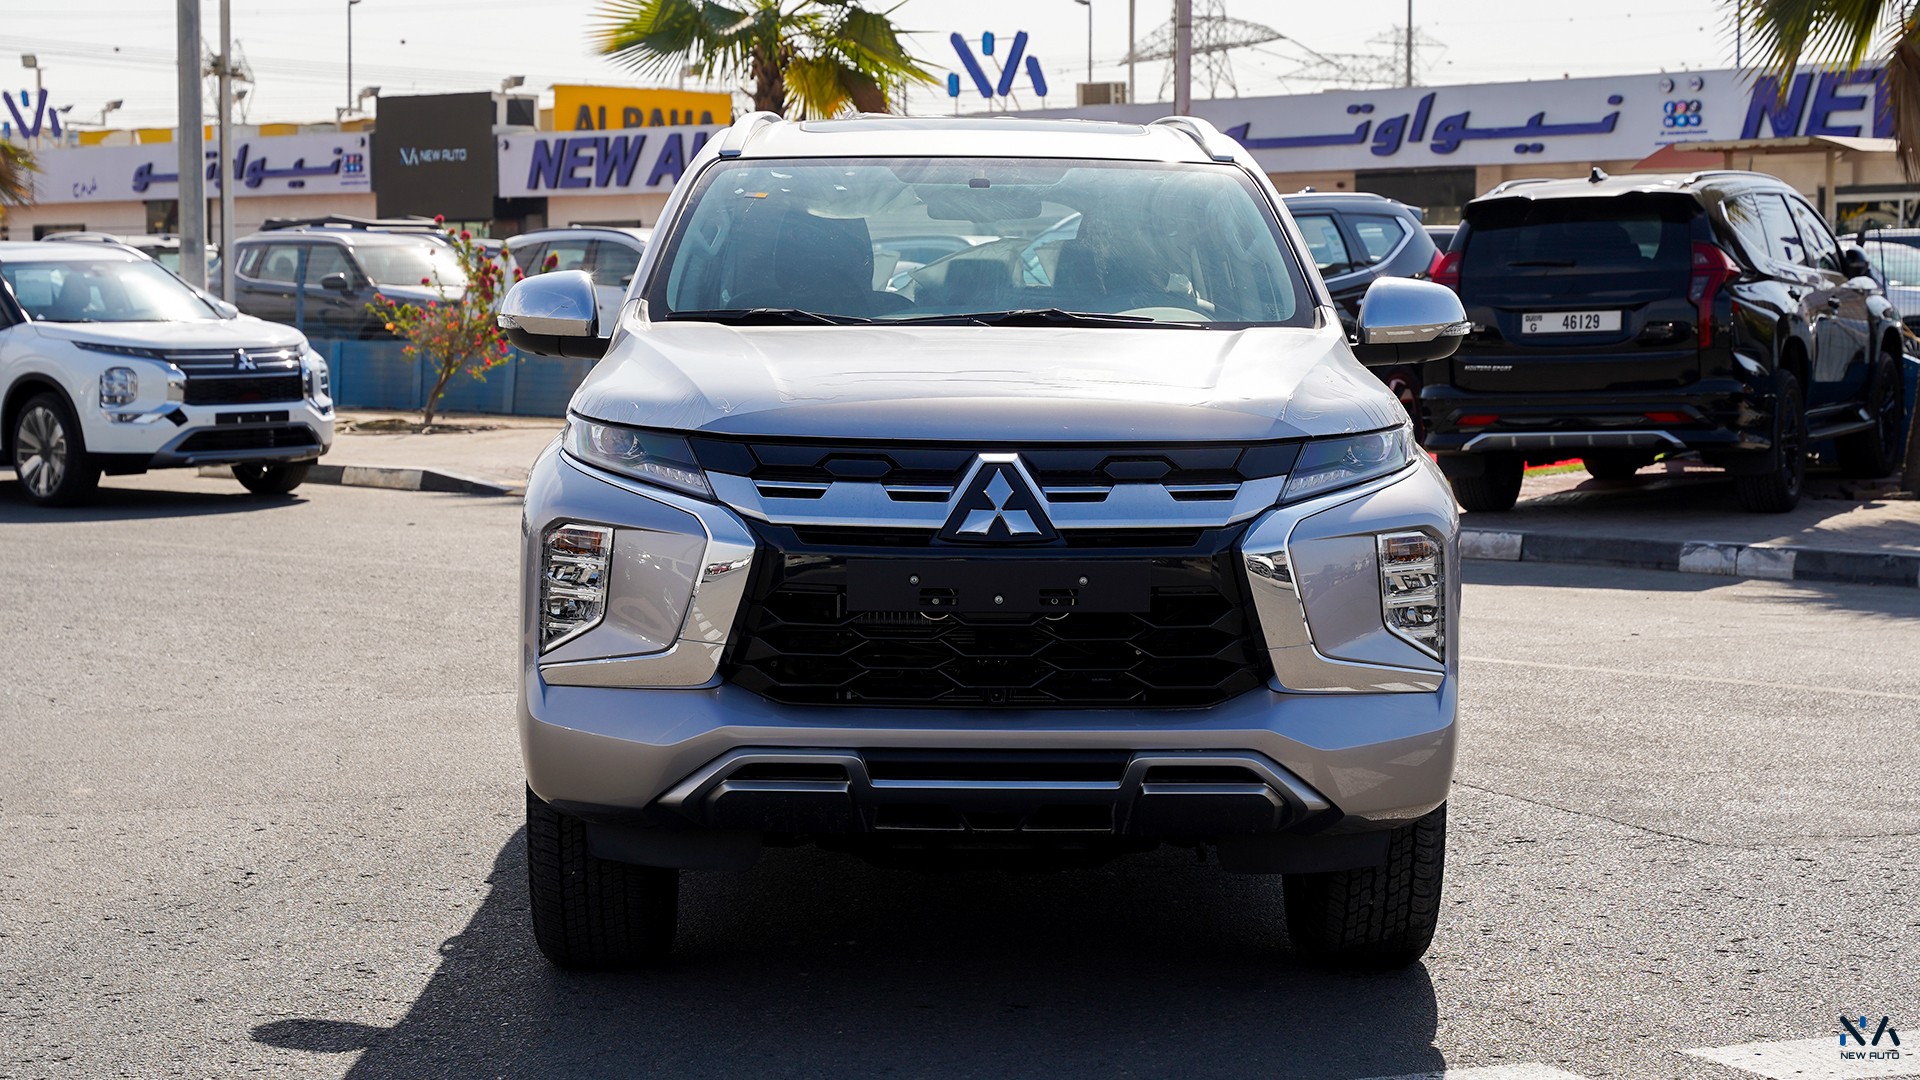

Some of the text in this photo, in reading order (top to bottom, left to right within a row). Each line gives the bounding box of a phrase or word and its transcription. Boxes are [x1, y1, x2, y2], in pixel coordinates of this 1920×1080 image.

[420, 149, 440, 162] NEW
[442, 148, 467, 161] AUTO
[526, 135, 647, 191] NEW
[1529, 314, 1600, 333] G 46129
